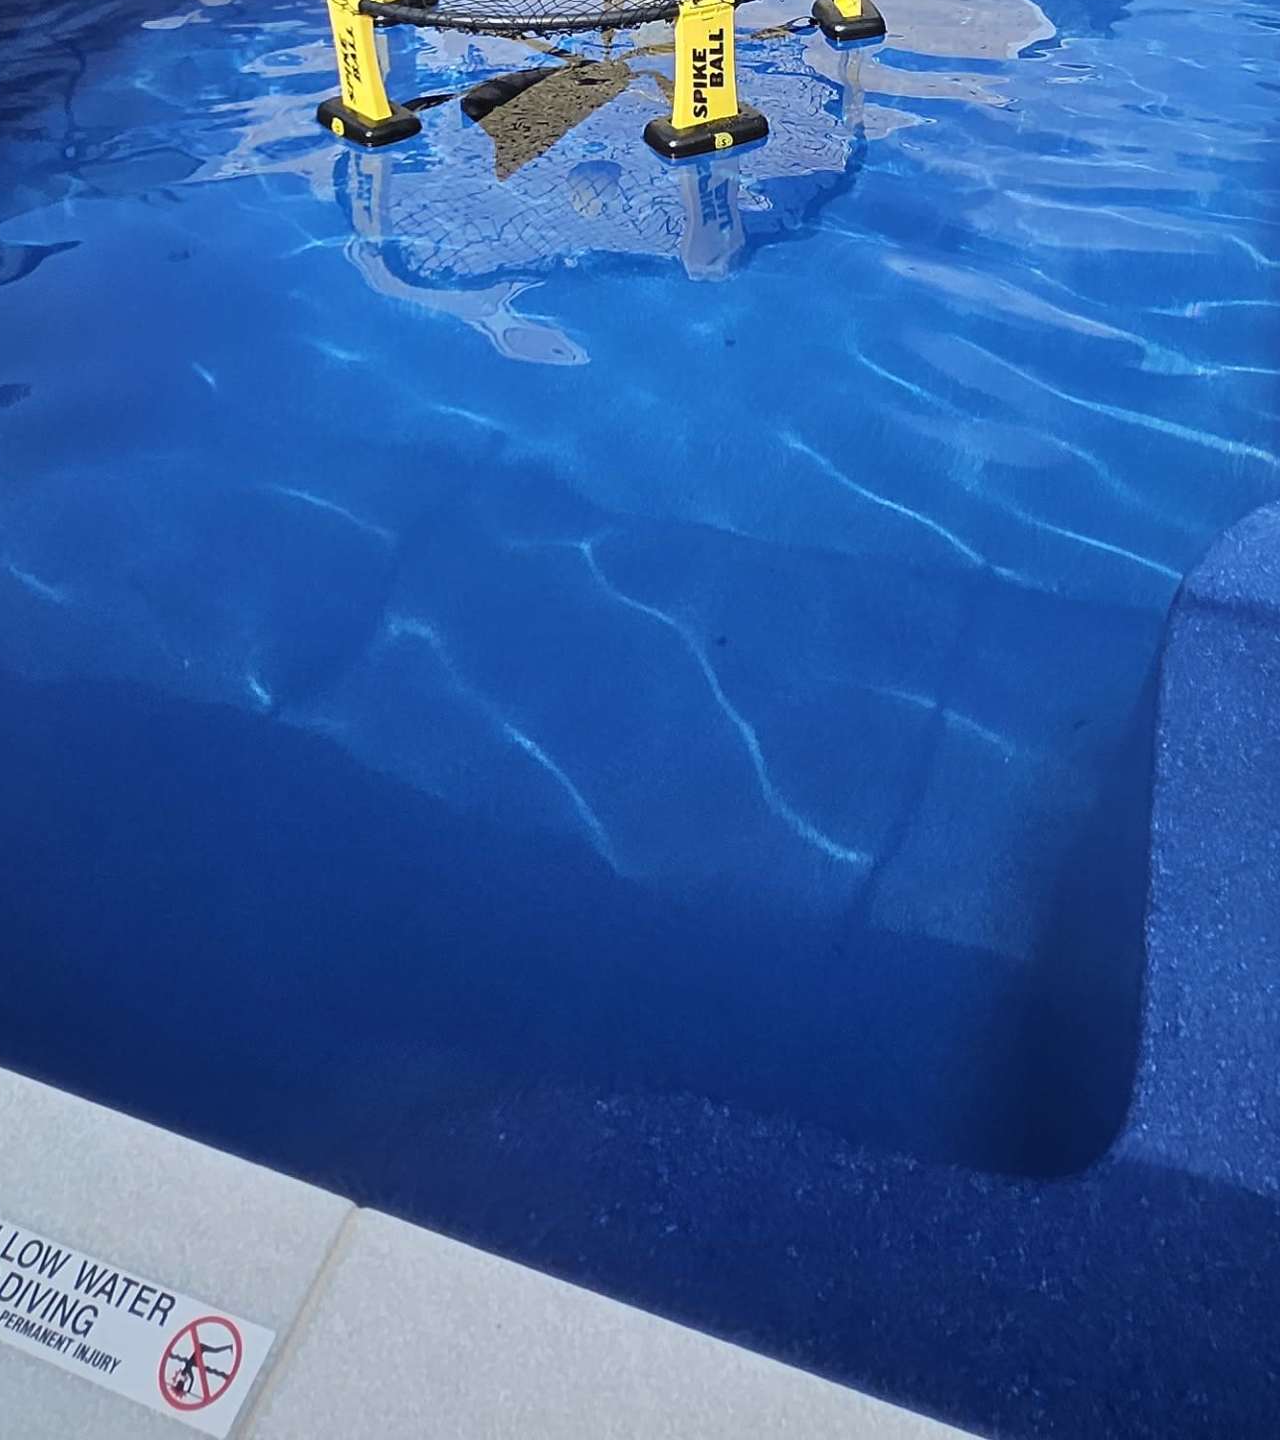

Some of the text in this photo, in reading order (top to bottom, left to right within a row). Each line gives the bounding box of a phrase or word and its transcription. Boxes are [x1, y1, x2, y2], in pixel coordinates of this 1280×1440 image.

[692, 48, 708, 118] SPIKE
[708, 28, 724, 88] BALL
[73, 1260, 177, 1327] WATER
[72, 1342, 122, 1375] INJURY
